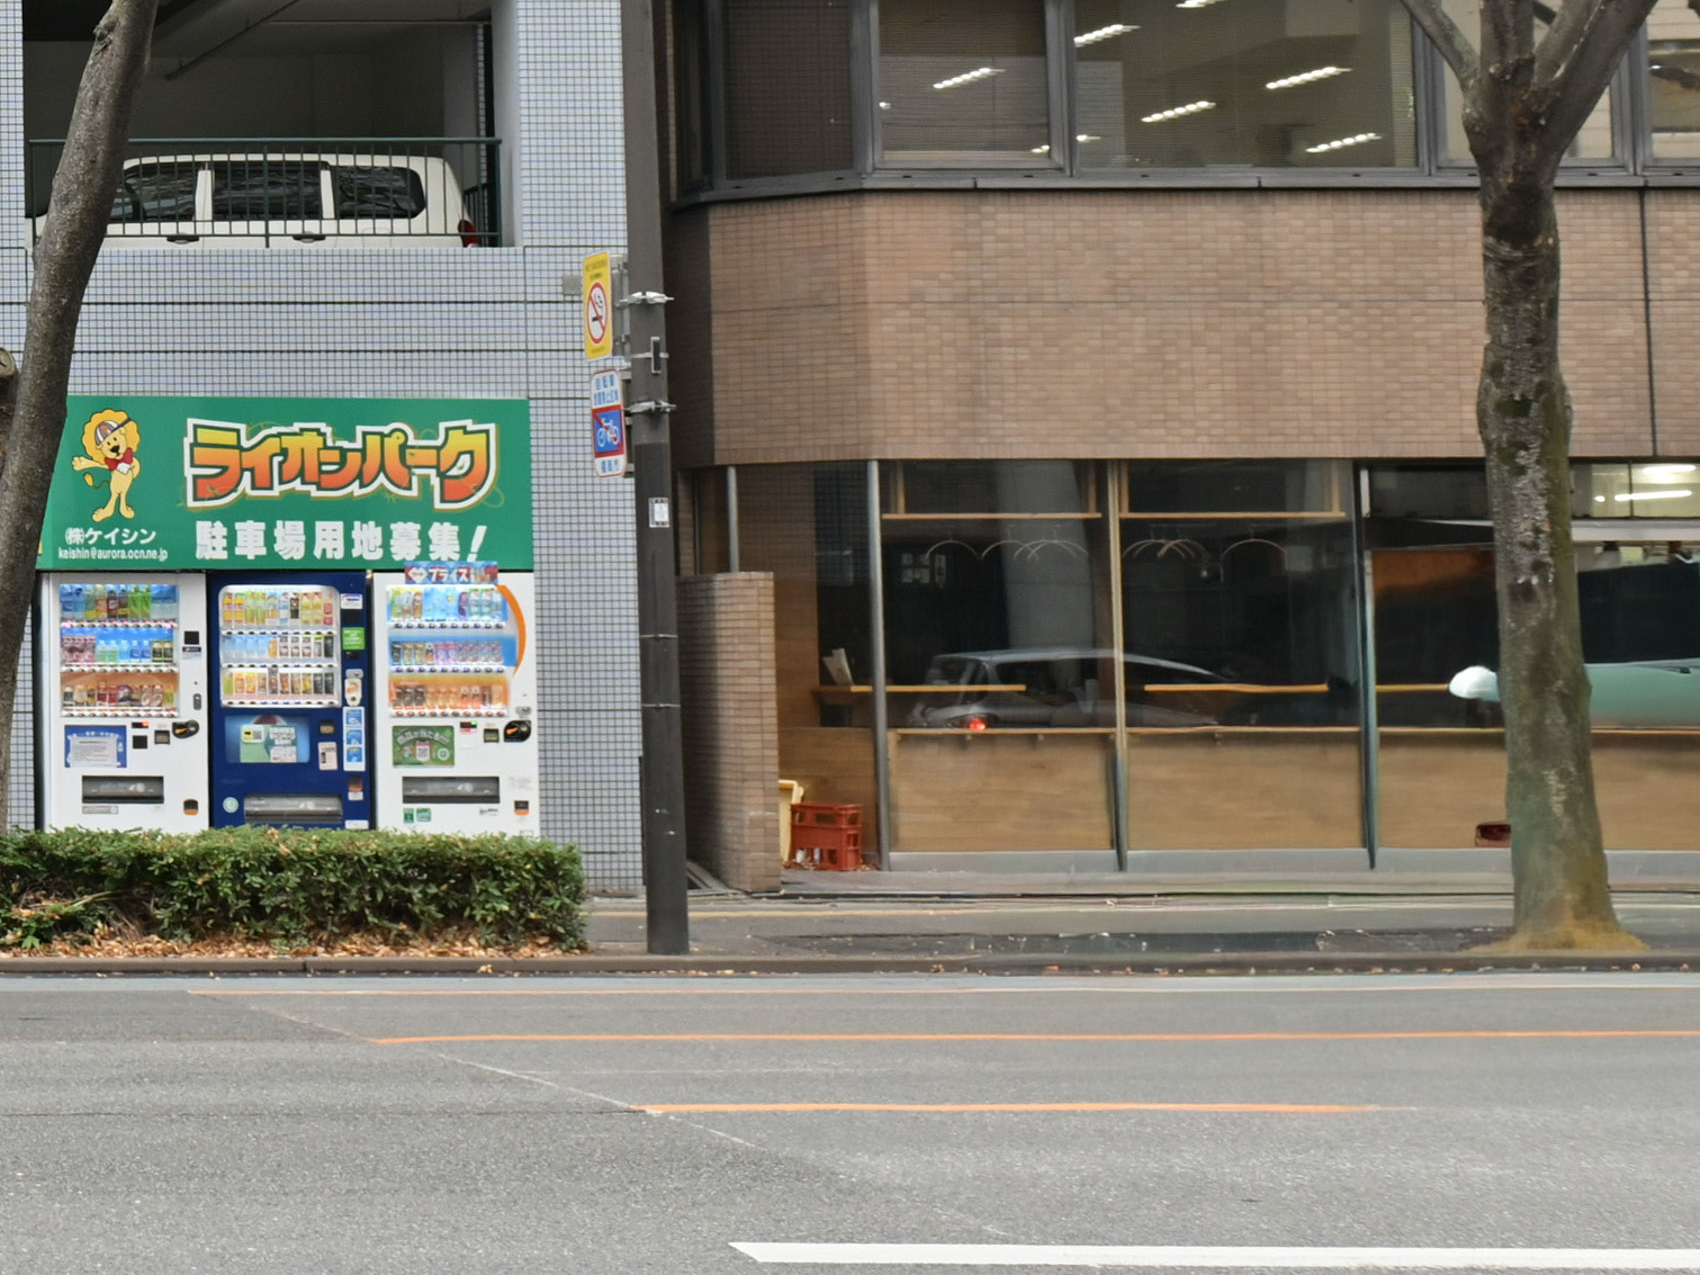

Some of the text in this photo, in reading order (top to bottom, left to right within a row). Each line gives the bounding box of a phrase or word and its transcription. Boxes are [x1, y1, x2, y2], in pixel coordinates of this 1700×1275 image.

[186, 419, 496, 509] ライオンパーク
[58, 547, 169, 562] keishin@aurora.ocn.ne.jp
